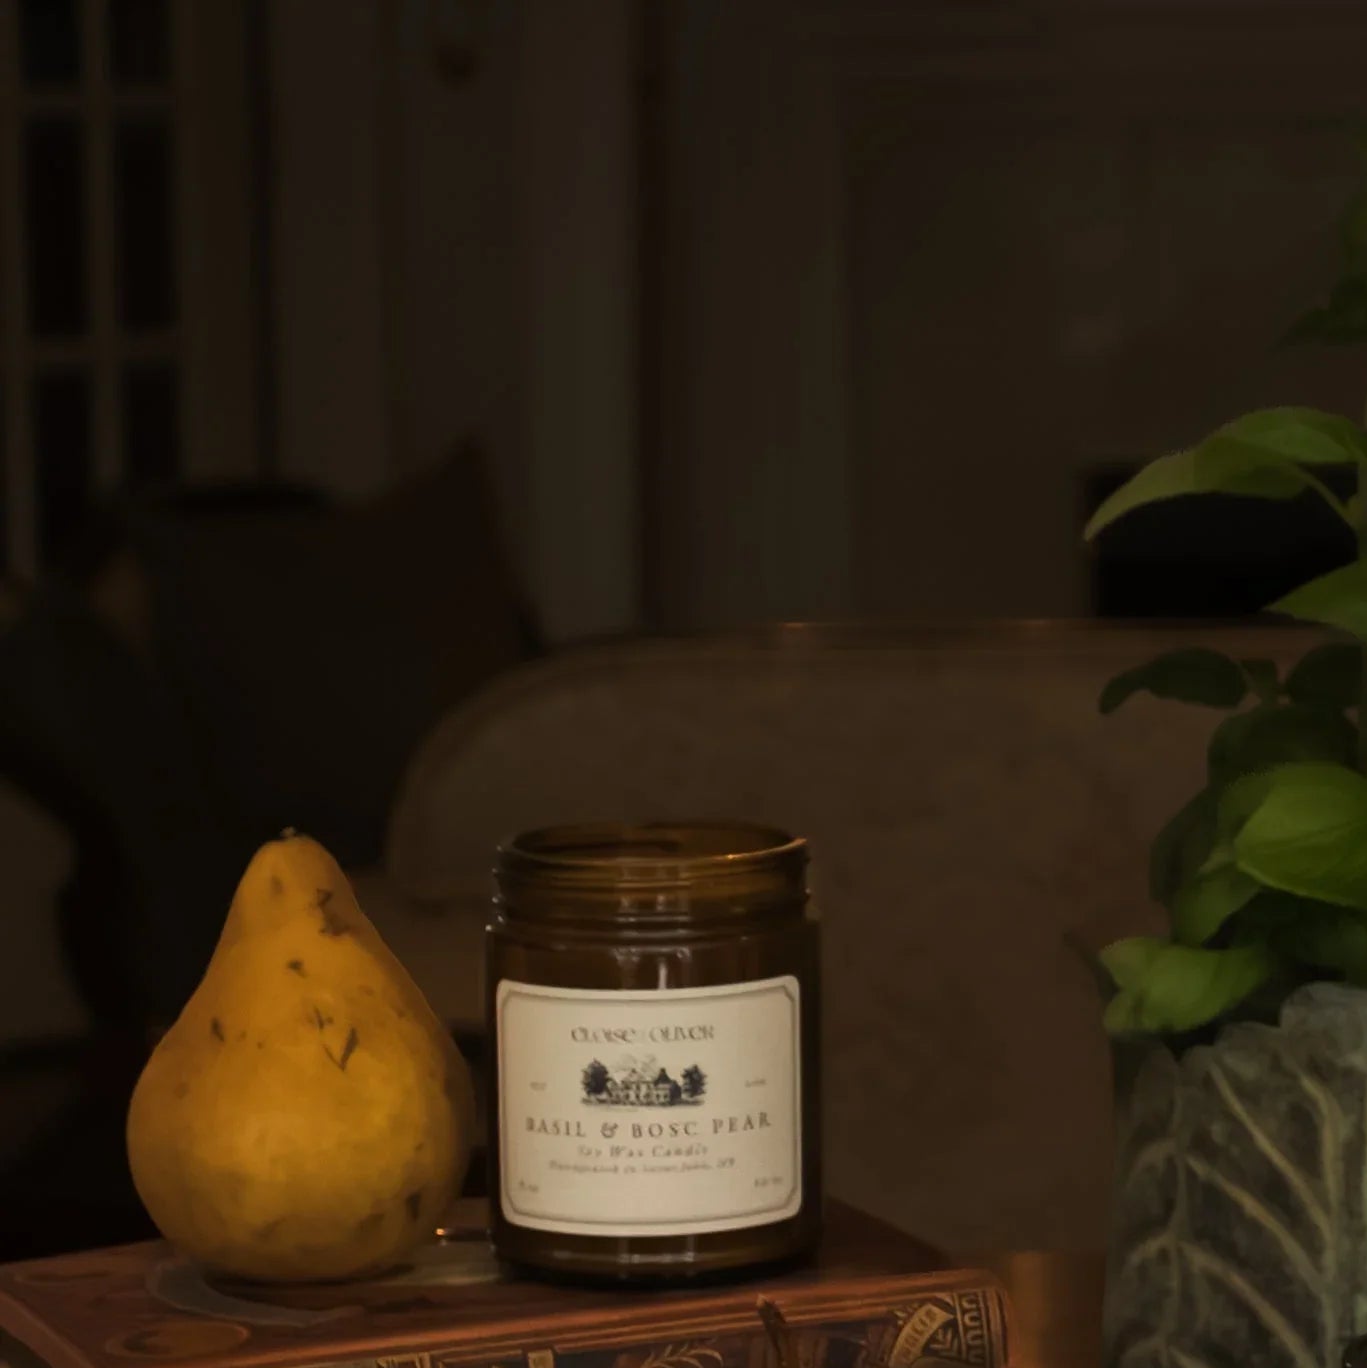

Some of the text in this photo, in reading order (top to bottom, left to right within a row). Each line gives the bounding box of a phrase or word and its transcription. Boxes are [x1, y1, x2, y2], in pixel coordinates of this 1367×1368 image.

[525, 1111, 772, 1139] BASIL & BOSC PEAR
